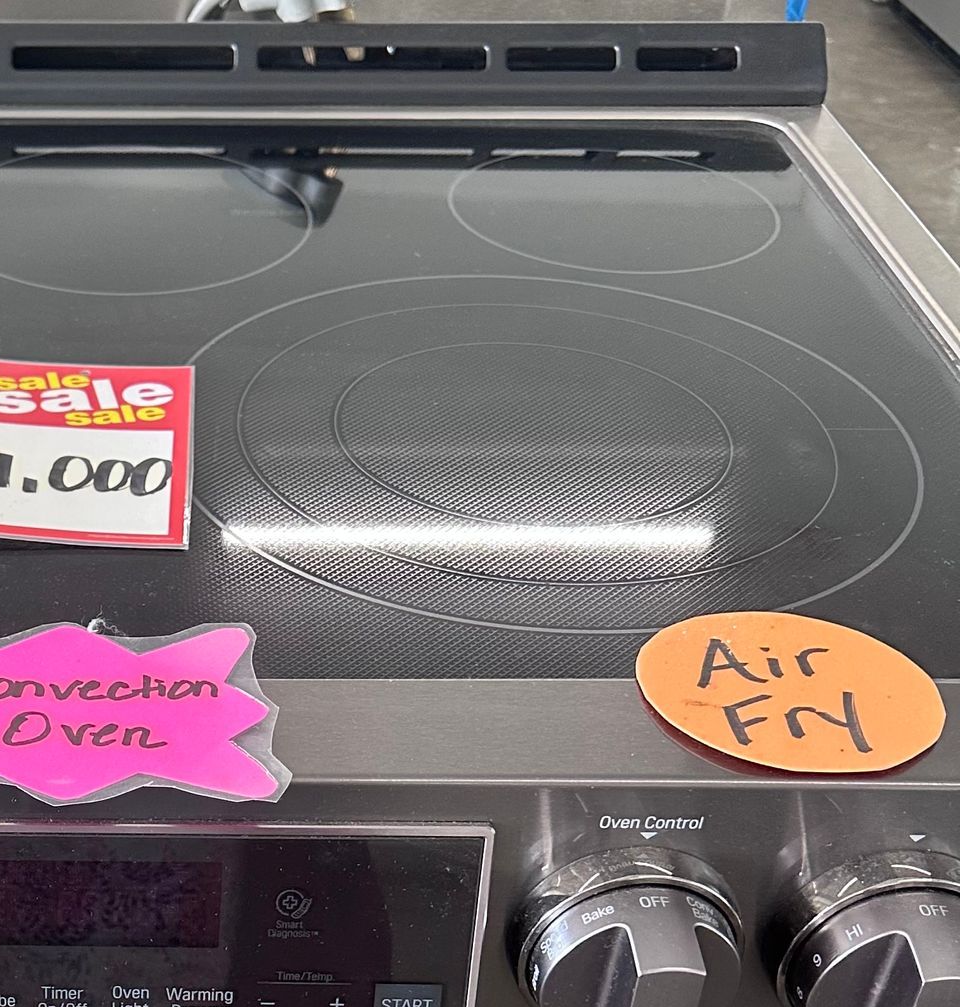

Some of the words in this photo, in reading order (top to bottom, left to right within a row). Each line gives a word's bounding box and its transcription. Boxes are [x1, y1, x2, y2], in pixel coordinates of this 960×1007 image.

[64, 405, 166, 426] sale
[696, 638, 830, 689] Air
[1, 711, 168, 749] Oven
[598, 815, 642, 829] Oven
[644, 816, 704, 830] Control
[639, 896, 671, 908] OFF
[581, 905, 615, 925] Bake
[918, 904, 949, 917] OFF
[275, 920, 303, 929] Smart
[845, 923, 864, 941] HI
[41, 986, 84, 1000] Timer
[112, 985, 150, 1000] Oven
[166, 987, 234, 1004] Warming
